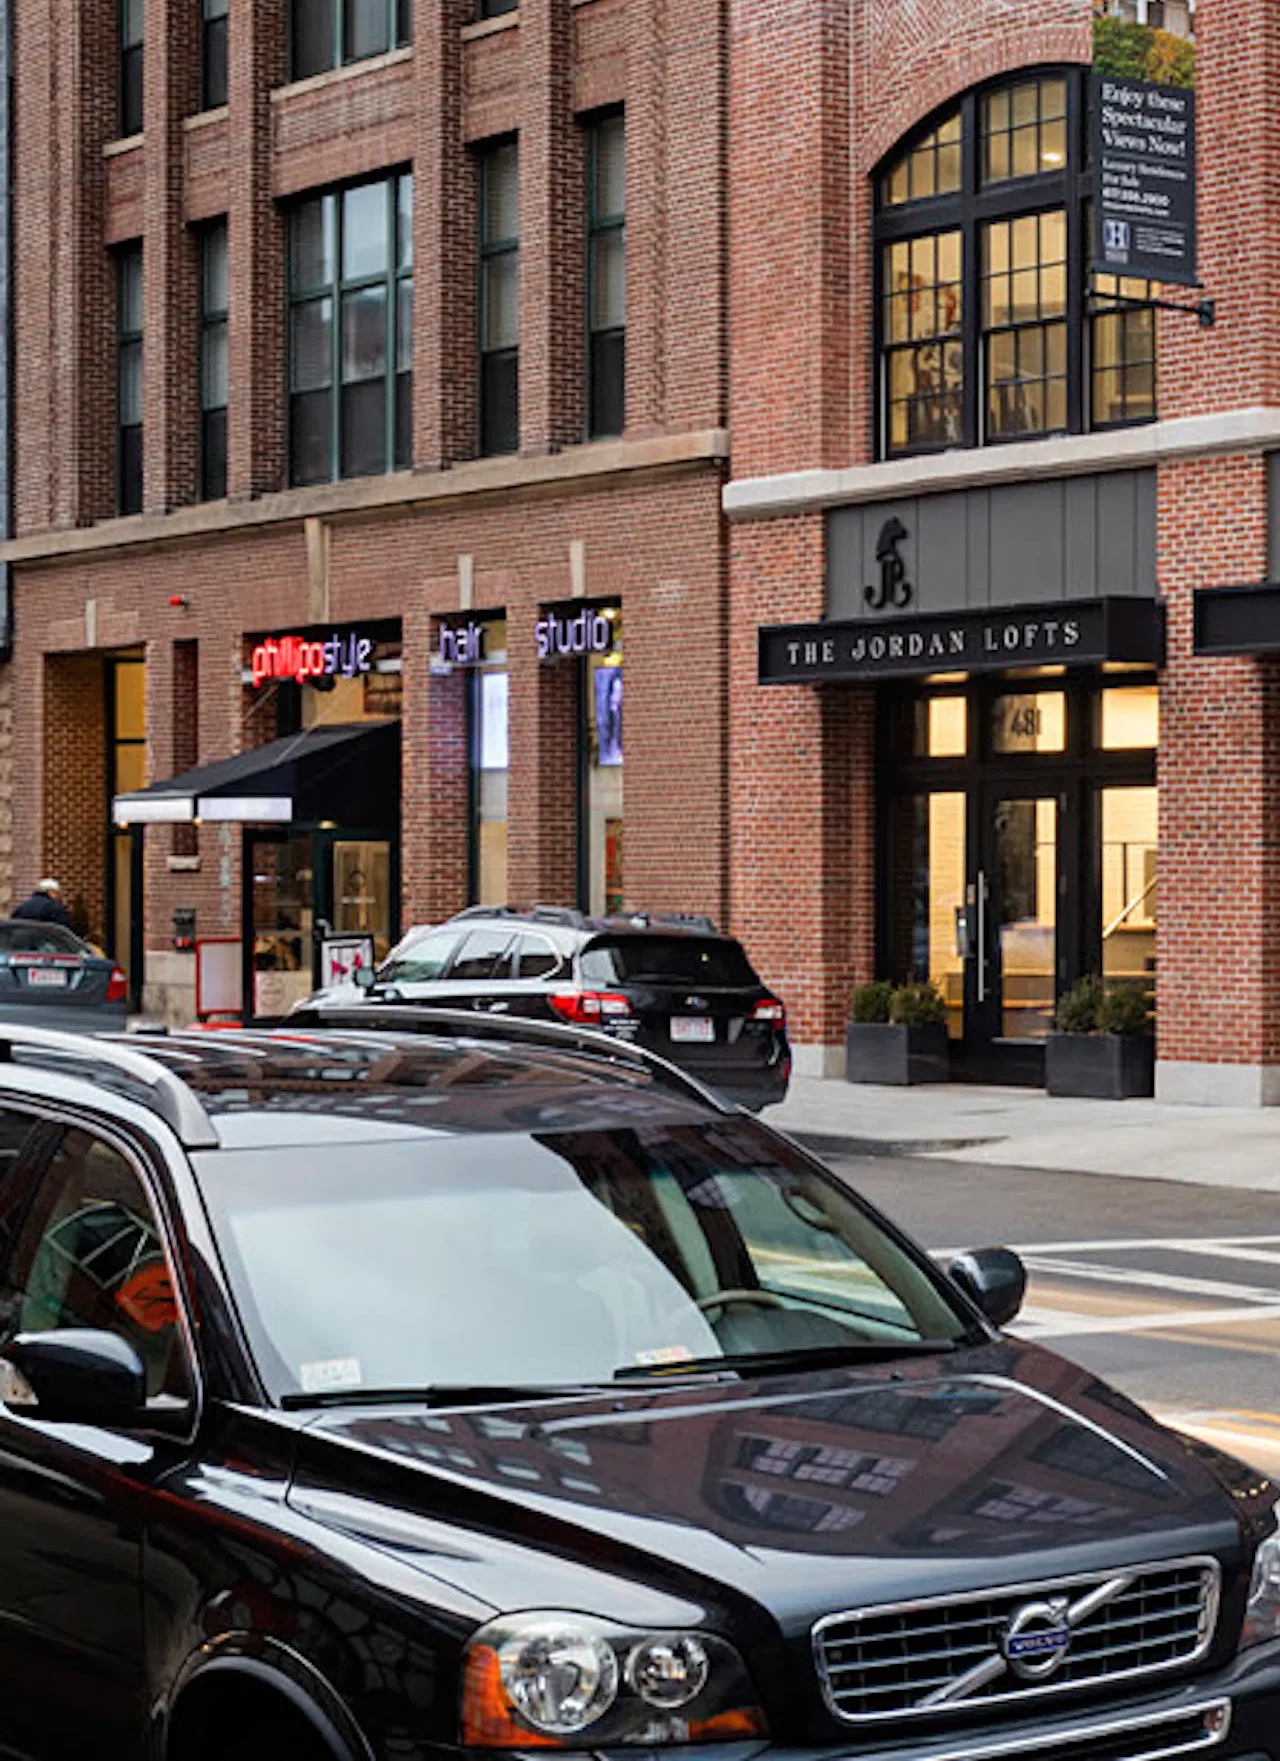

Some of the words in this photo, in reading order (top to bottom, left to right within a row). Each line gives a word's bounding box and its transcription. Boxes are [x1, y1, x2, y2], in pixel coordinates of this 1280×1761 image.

[1101, 82, 1145, 109] Enjoy
[1101, 105, 1187, 136] Spectacular
[1101, 128, 1148, 152] Views
[1148, 134, 1186, 158] Now!
[439, 620, 485, 665] hair
[535, 607, 612, 660] studio
[786, 640, 837, 667] THE
[850, 628, 967, 663] JORDAN
[983, 620, 1082, 652] LOFTS
[1010, 708, 1043, 739] 481
[1013, 1635, 1066, 1650] VOLVO
